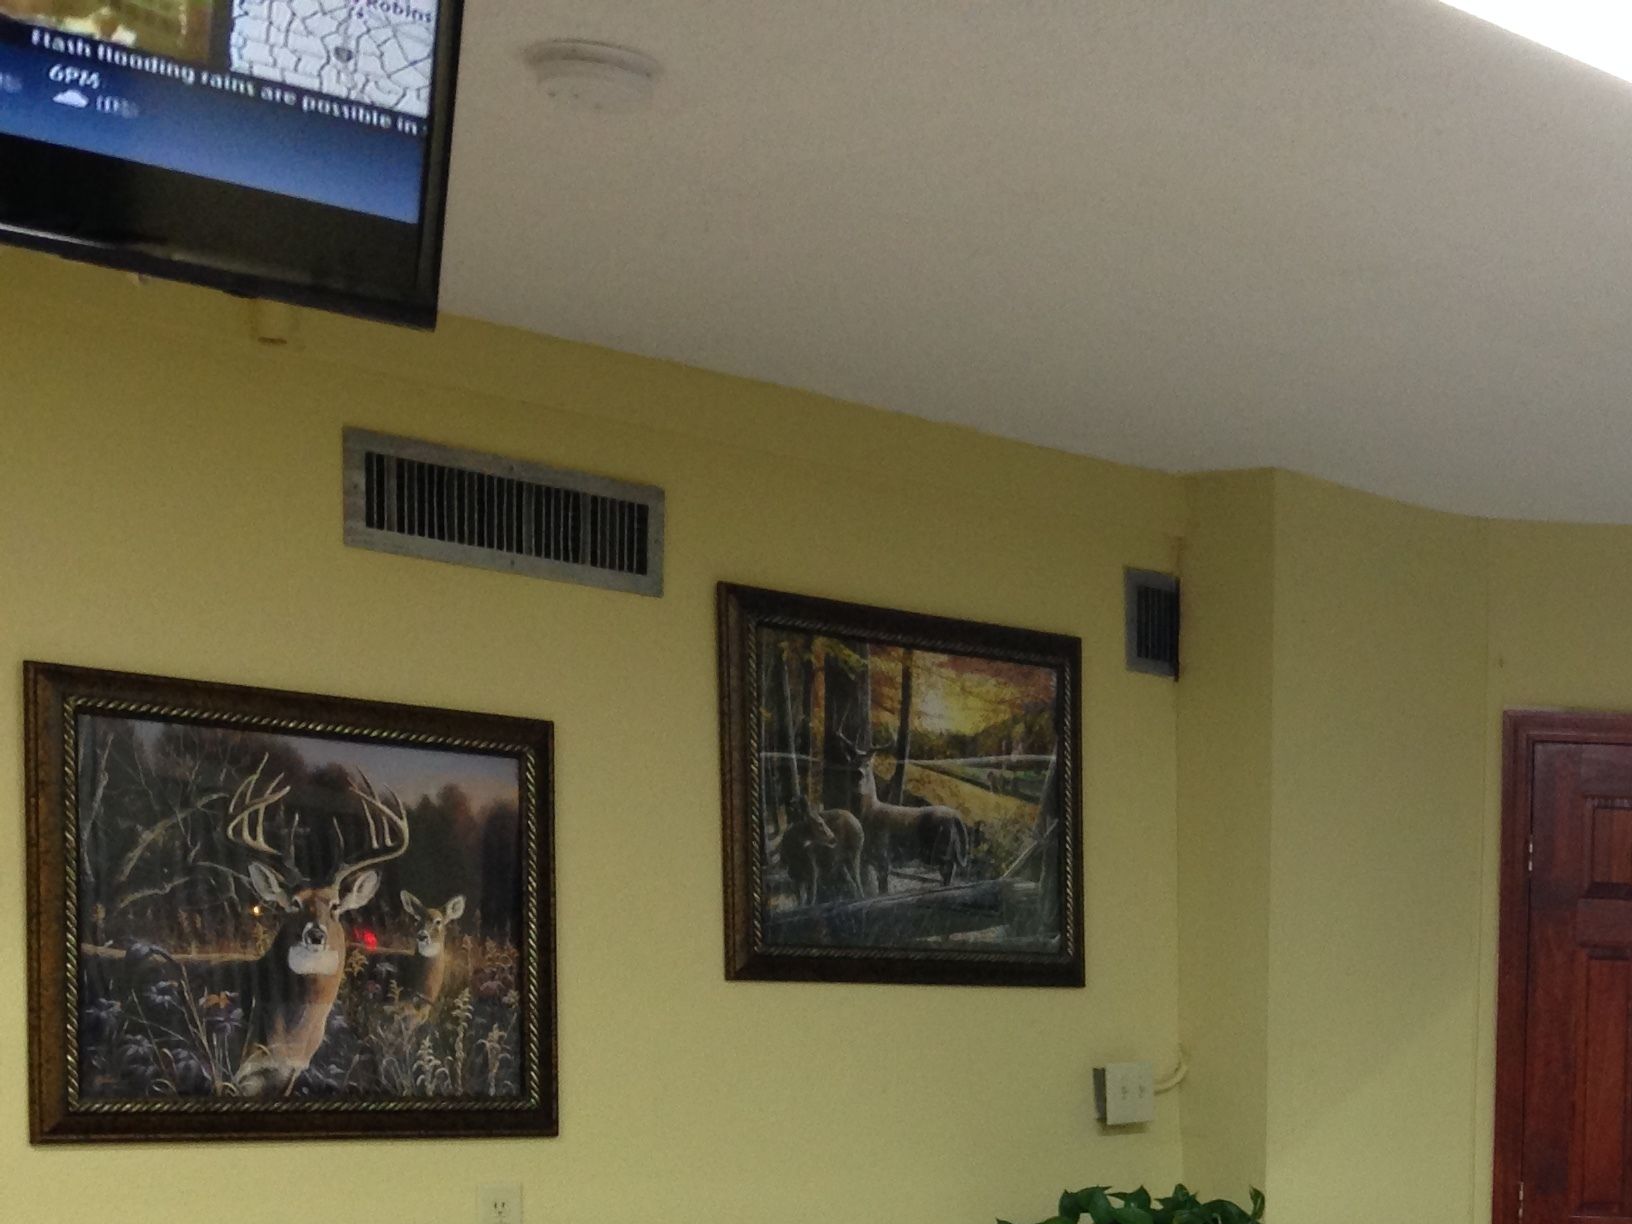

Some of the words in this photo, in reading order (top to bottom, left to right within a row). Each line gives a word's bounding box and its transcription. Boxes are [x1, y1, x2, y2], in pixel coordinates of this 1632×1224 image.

[31, 28, 92, 58] Flash
[97, 42, 196, 86] flooding
[260, 86, 297, 106] are
[302, 94, 393, 130] possible
[49, 63, 101, 90] 6PM
